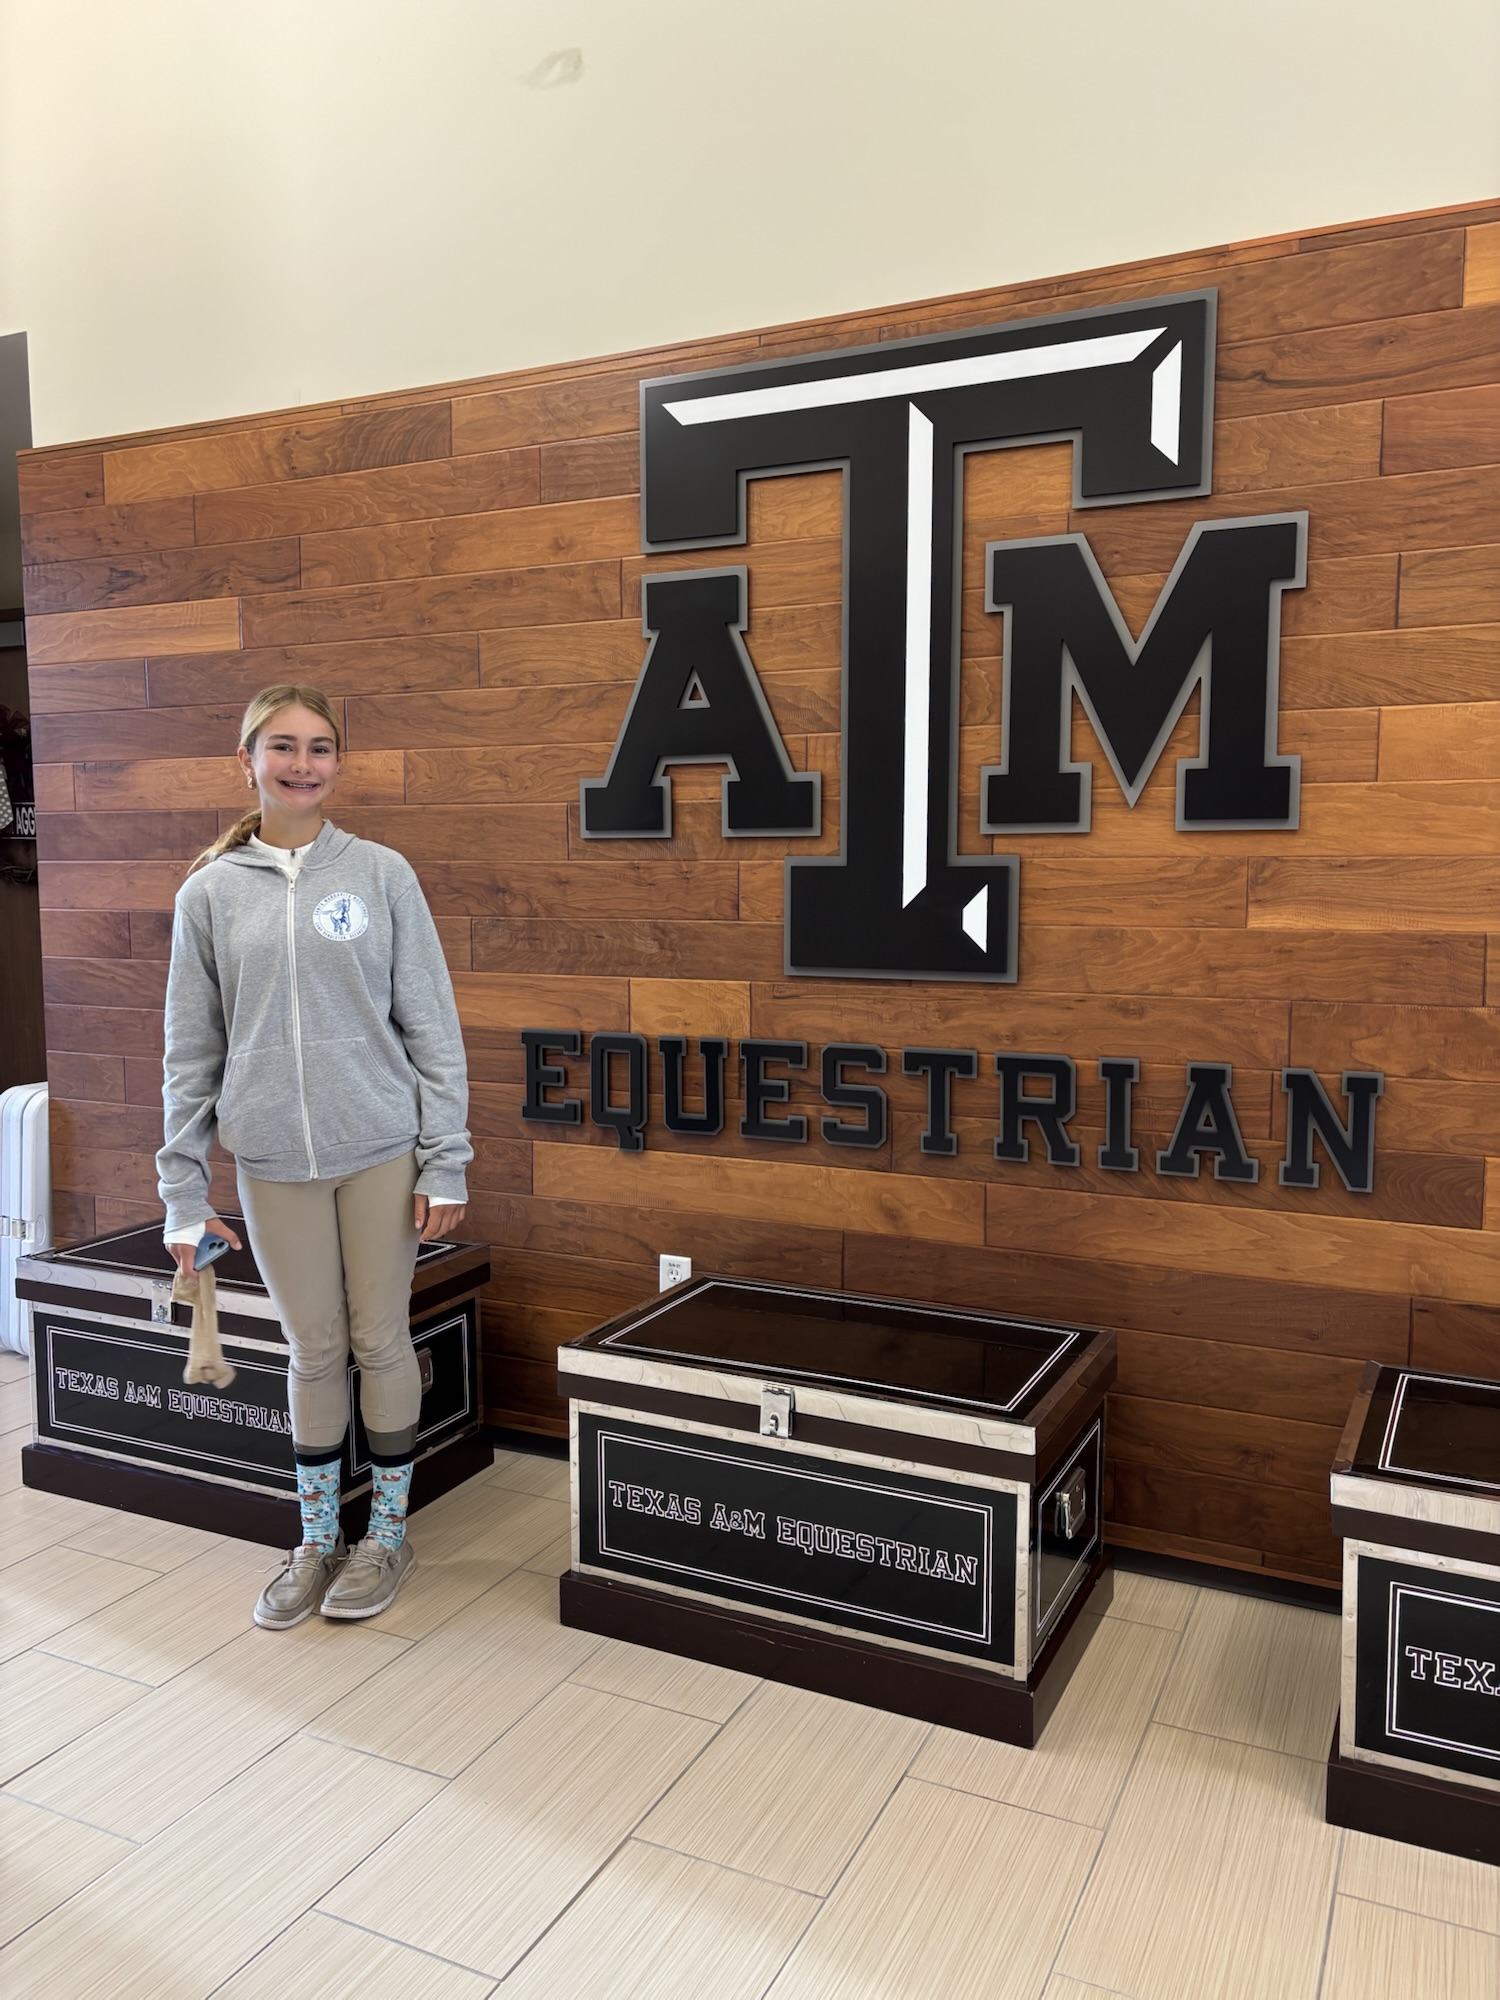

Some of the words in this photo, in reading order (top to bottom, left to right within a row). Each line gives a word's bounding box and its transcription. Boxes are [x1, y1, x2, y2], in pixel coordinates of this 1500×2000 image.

[15, 806, 36, 836] AGG
[520, 1027, 1385, 1194] EQUESTRIAN
[55, 1366, 120, 1401] TEXAS
[123, 1380, 162, 1409] A&M
[608, 1479, 702, 1526] TEXAS
[709, 1502, 766, 1540] A&M
[776, 1515, 979, 1586] EQUESTRIAN
[1405, 1645, 1500, 1697] TEX
